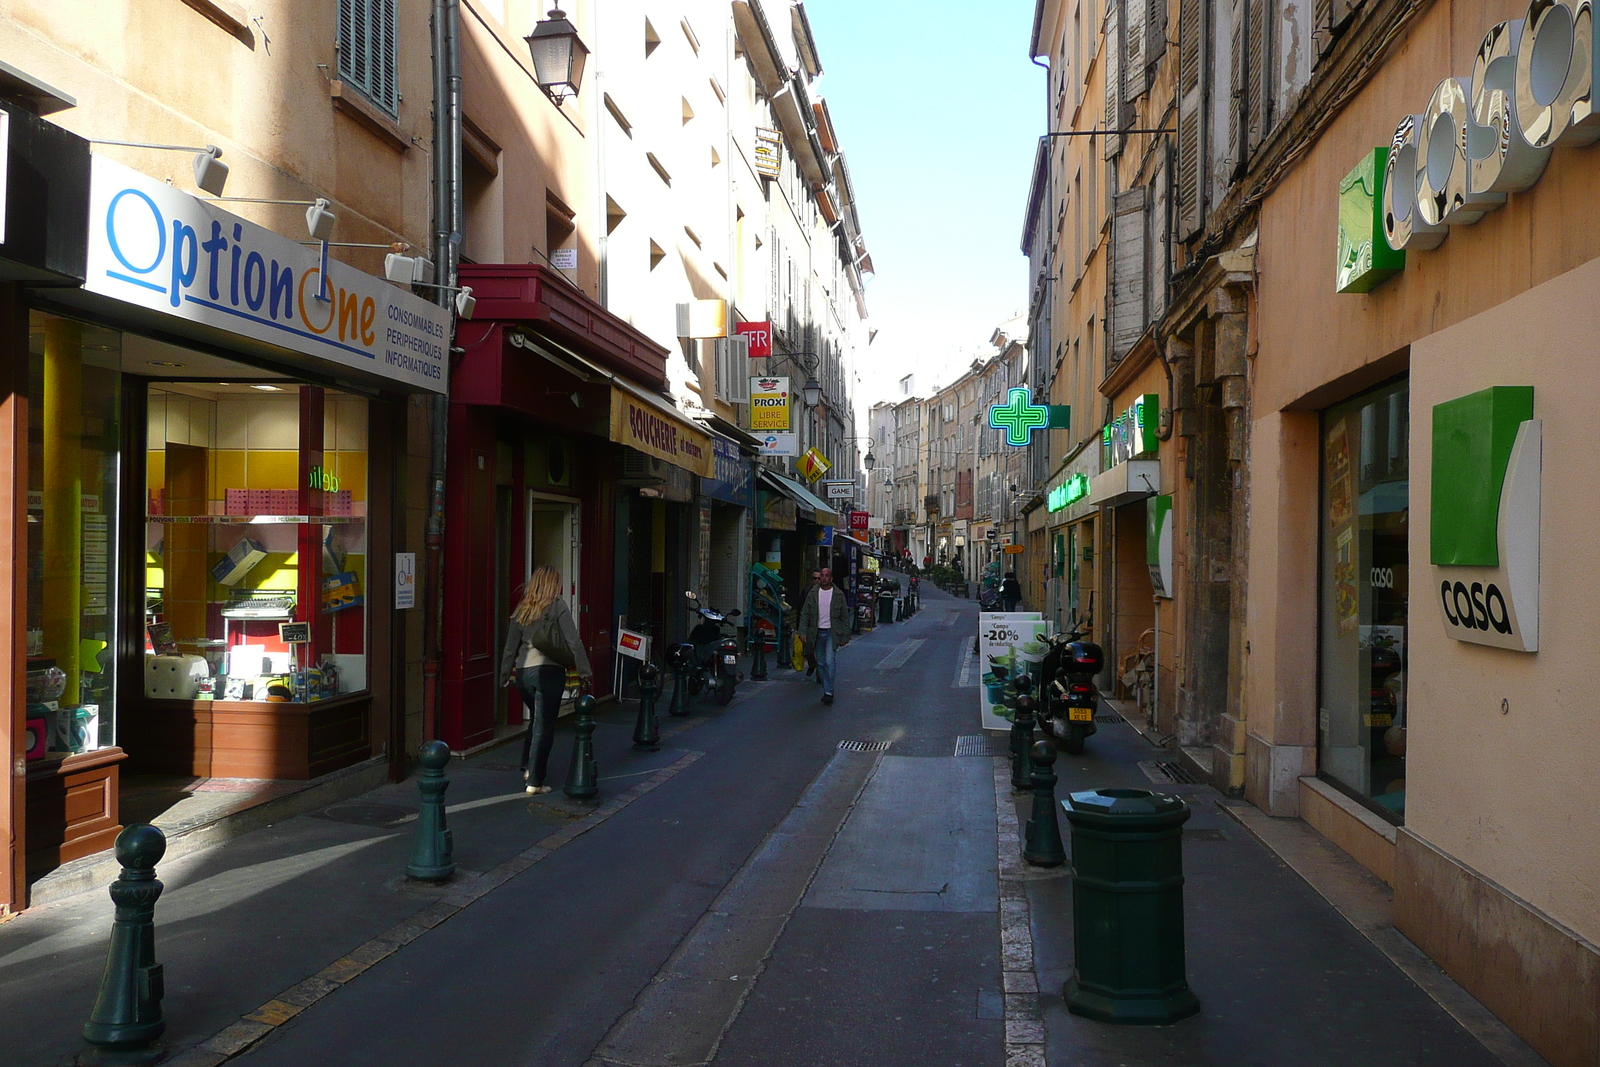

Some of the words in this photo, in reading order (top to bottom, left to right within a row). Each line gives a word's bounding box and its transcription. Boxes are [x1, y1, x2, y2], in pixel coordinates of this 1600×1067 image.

[1382, 0, 1594, 251] casa
[387, 303, 444, 339] CONSOMMABLES
[385, 328, 443, 361] PERIPHERIQUES
[741, 330, 768, 348] FR
[384, 348, 442, 381] INFORMATIQUES
[754, 398, 786, 407] PROXI
[753, 420, 788, 428] SERVICE
[759, 411, 781, 419] LIBRE
[629, 403, 677, 456] BOUCHERIE
[852, 515, 867, 525] SFR
[1370, 566, 1394, 589] casa
[1440, 579, 1514, 637] casa
[983, 630, 1019, 641] -20%
